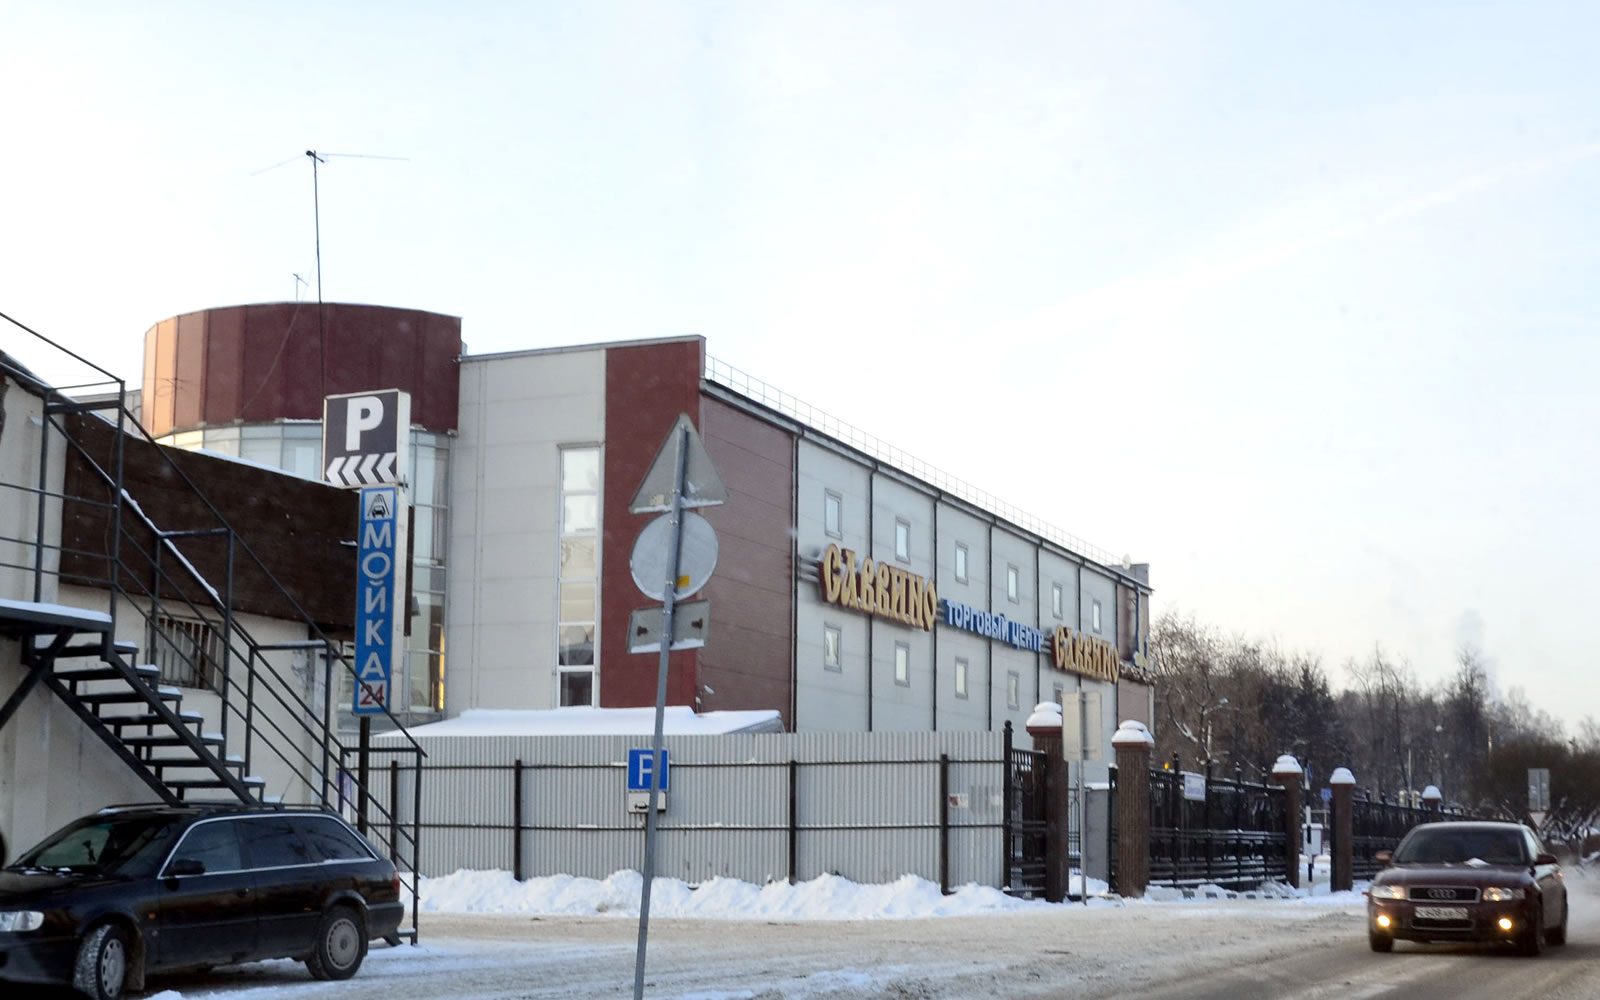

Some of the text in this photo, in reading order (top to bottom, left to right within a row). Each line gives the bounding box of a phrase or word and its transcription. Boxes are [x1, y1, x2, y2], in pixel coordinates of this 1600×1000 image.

[345, 395, 384, 452] P
[359, 521, 393, 680] МОЙКА
[944, 599, 1010, 643] ТОРГОВЫЙ
[1011, 621, 1045, 653] ЦЕНТР
[360, 683, 385, 706] 24
